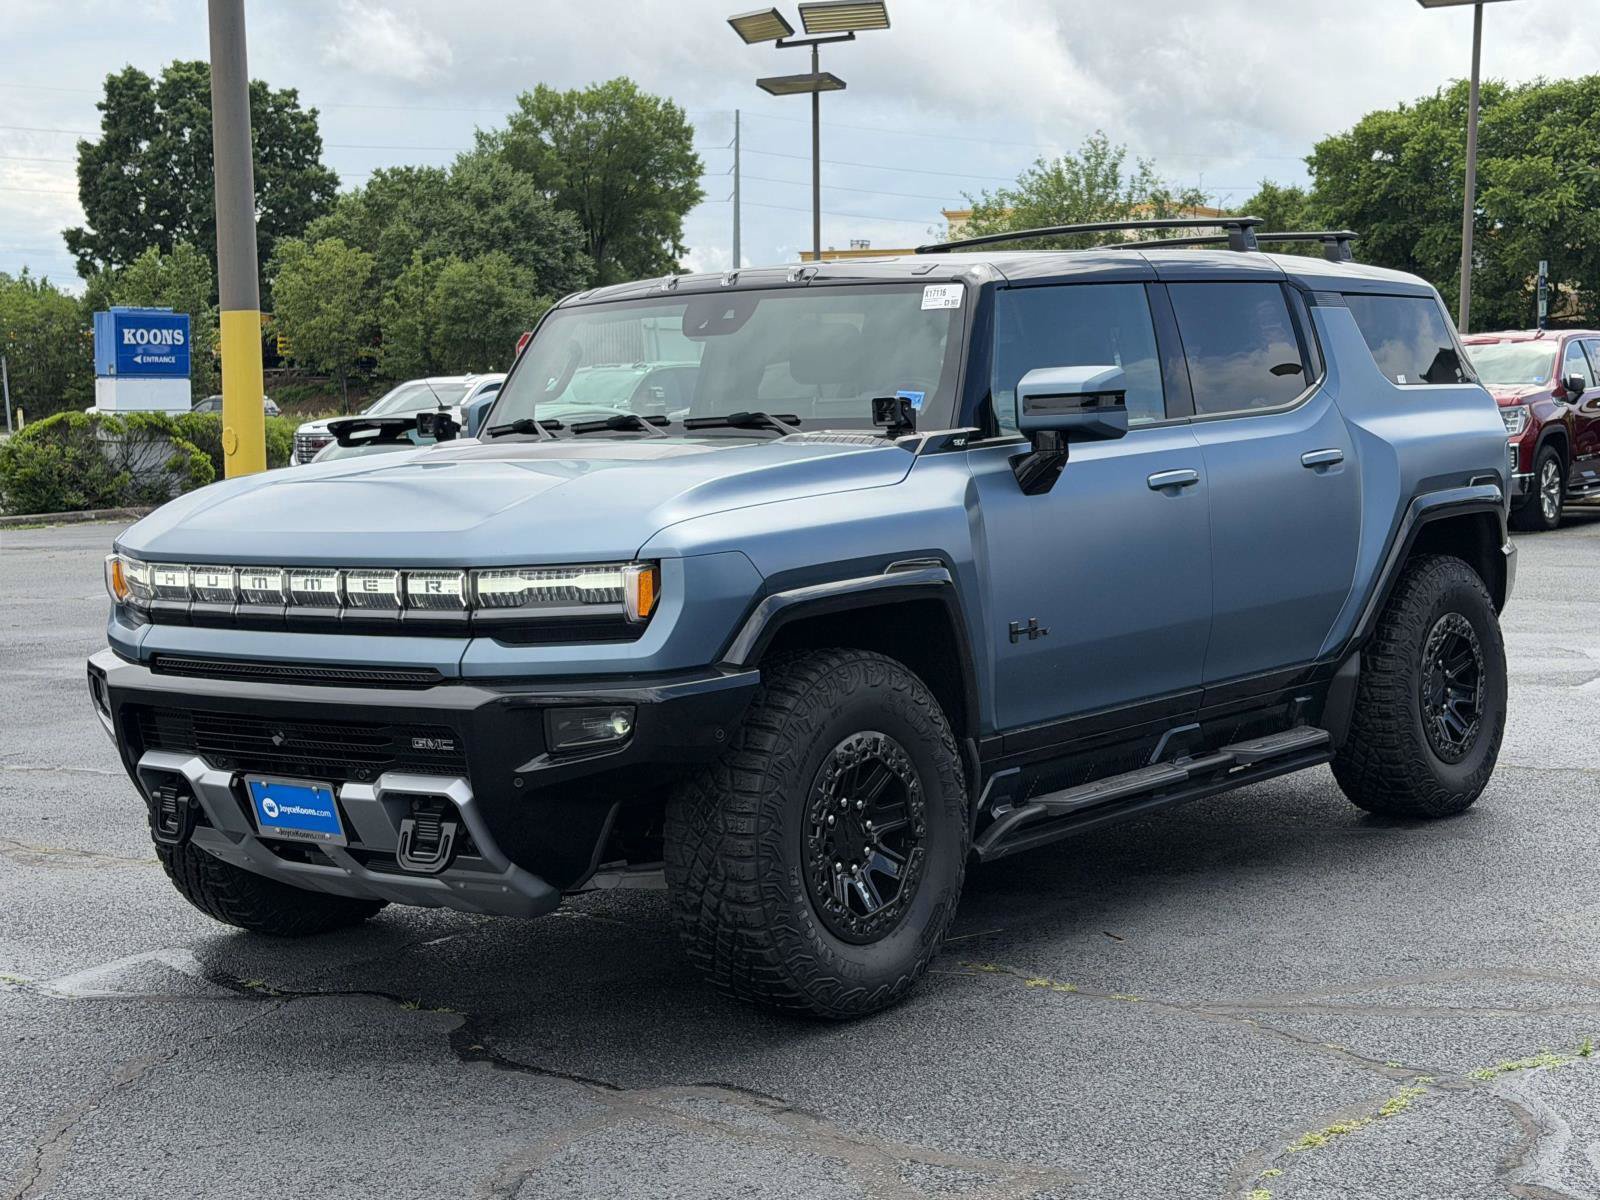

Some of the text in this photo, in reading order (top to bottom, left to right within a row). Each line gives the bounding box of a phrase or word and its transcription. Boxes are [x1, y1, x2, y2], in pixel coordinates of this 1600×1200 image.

[123, 328, 184, 345] KOONS
[165, 573, 442, 593] HUMMER
[411, 737, 455, 751] GMC
[279, 804, 332, 817] JoyceKoons.com
